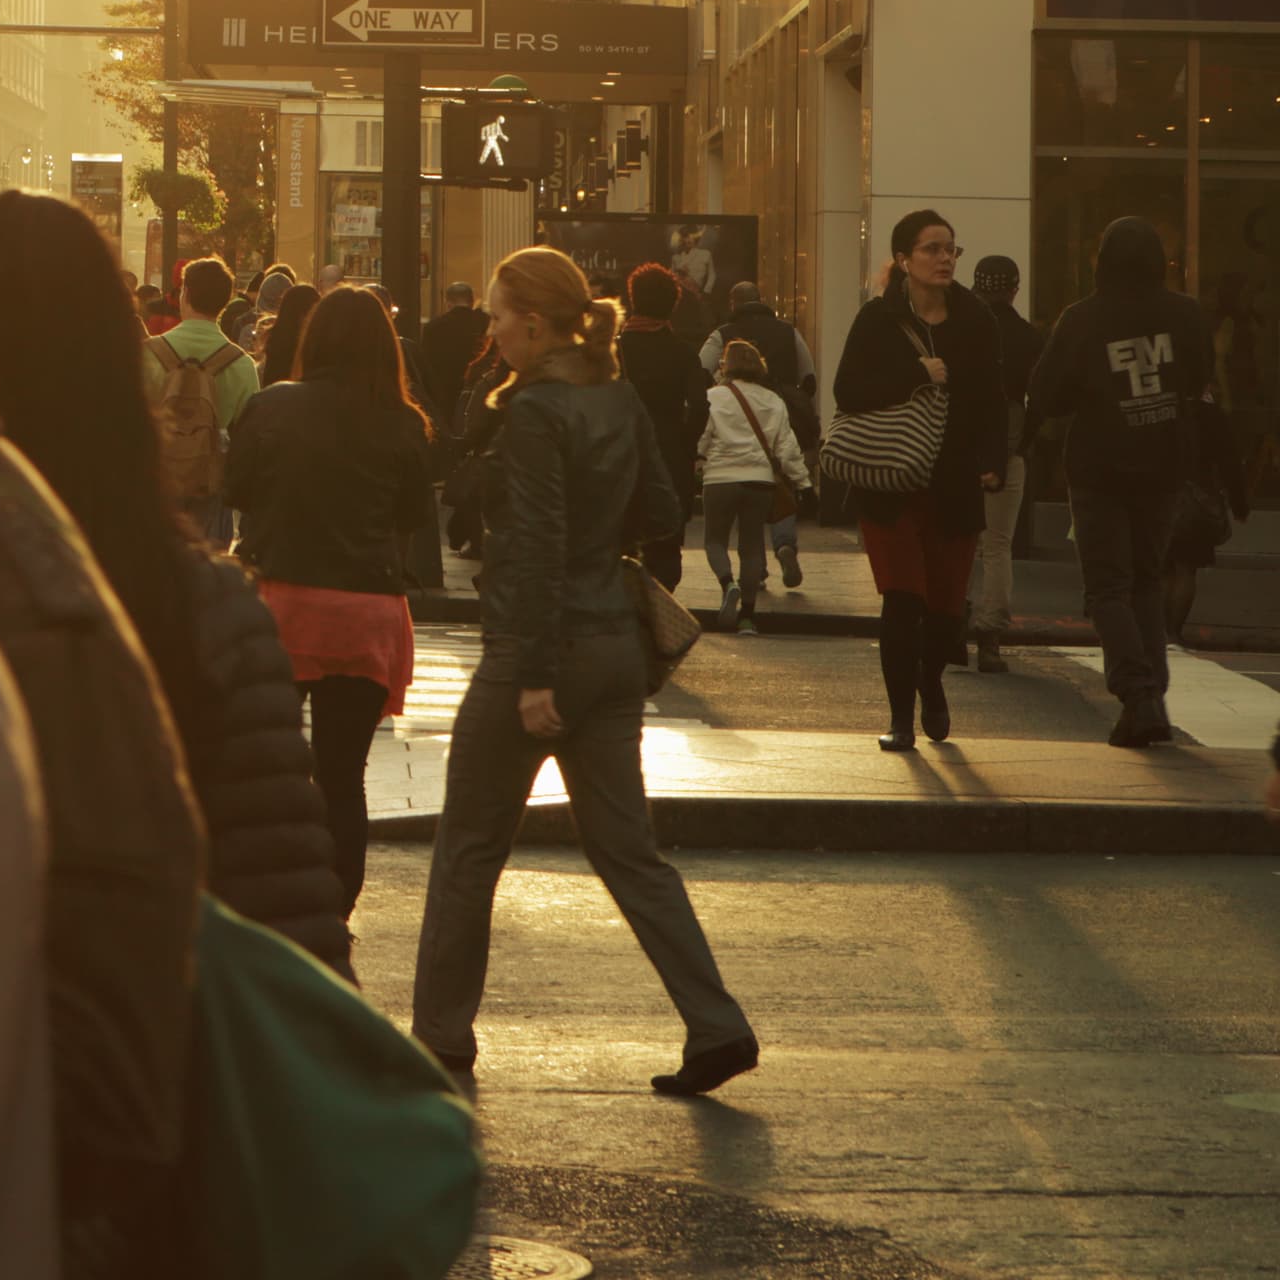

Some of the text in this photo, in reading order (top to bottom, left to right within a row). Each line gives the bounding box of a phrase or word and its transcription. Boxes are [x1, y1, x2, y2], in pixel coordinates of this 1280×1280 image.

[349, 10, 459, 30] ONE WAY
[494, 32, 559, 51] ERS
[288, 117, 305, 208] Newsstand
